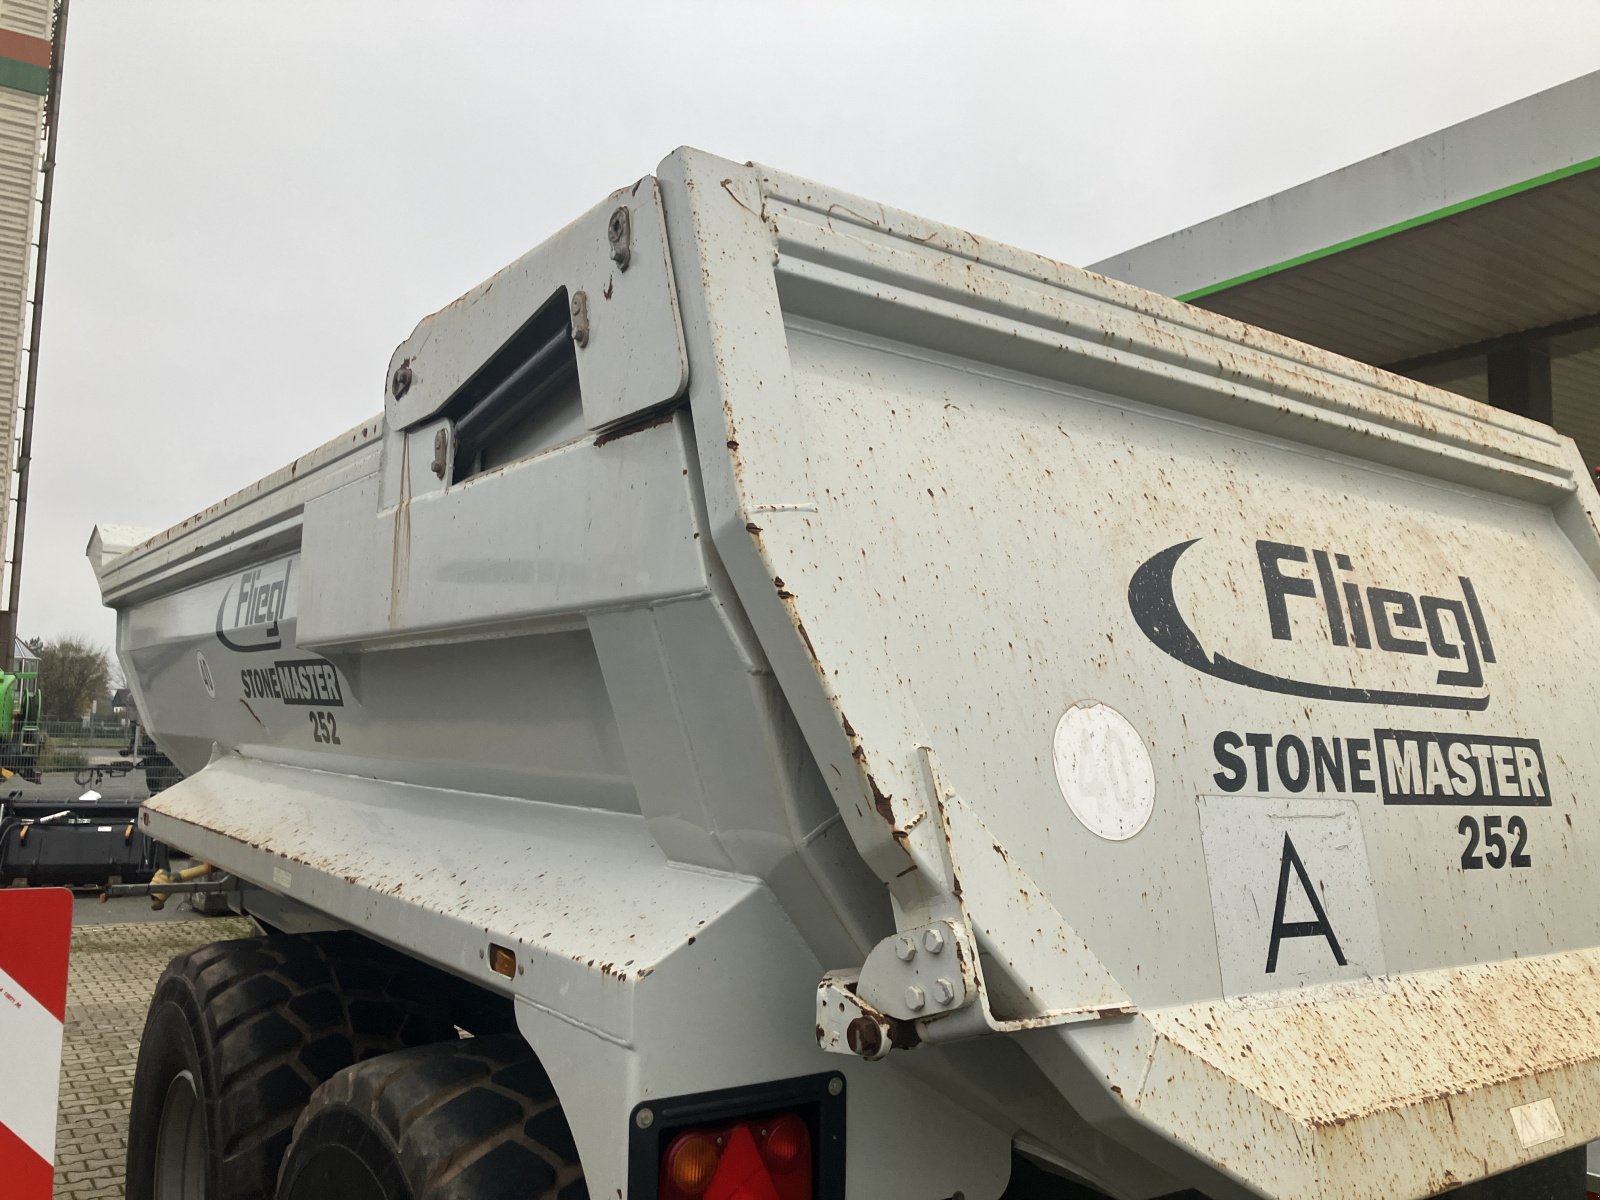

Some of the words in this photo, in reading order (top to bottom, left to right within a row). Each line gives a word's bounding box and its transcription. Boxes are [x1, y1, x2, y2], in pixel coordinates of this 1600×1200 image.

[234, 560, 292, 637] Fliegl
[1255, 540, 1496, 688] Fliegl
[309, 711, 341, 744] 252
[1457, 814, 1532, 870] 252
[1265, 831, 1348, 974] A
